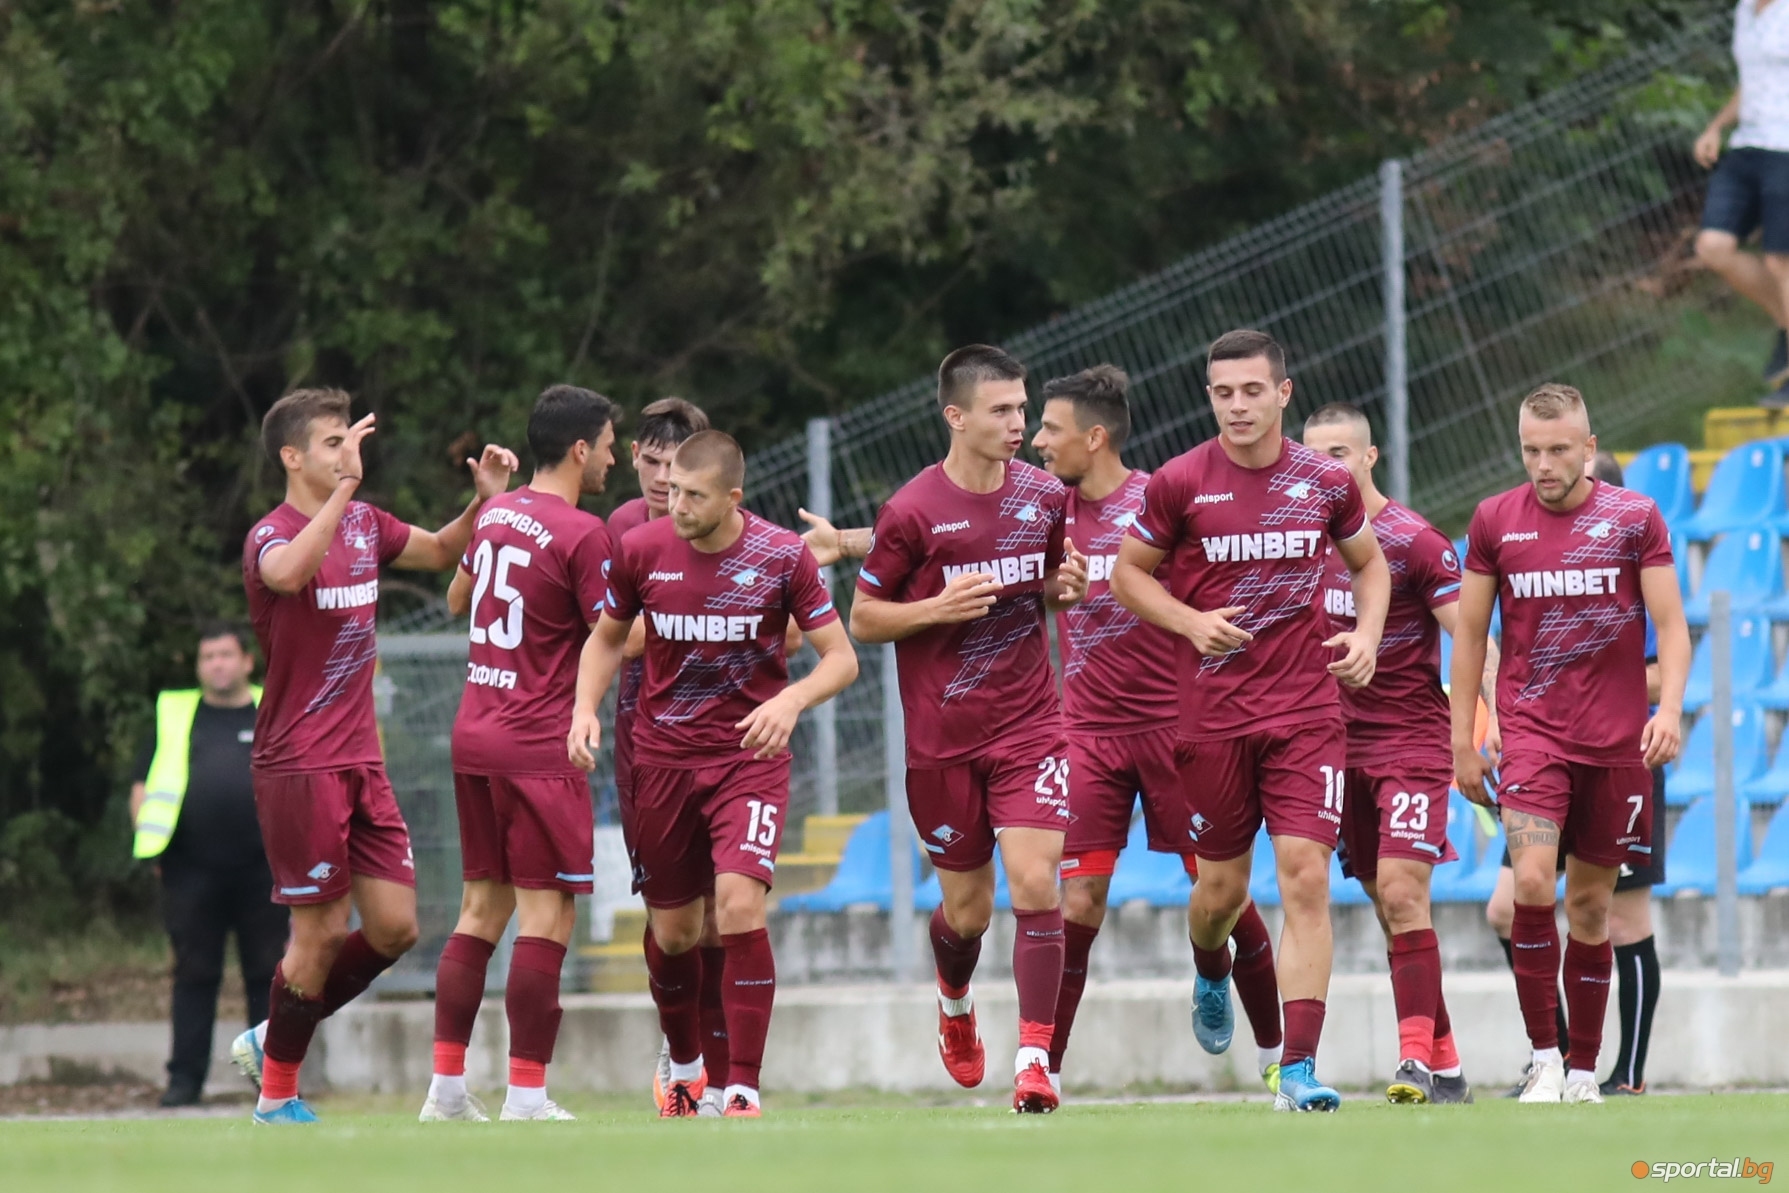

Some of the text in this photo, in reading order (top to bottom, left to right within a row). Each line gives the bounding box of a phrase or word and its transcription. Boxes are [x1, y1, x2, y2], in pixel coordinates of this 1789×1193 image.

[1194, 491, 1234, 505] uhlsport
[930, 519, 971, 535] uhlsport
[1501, 531, 1539, 543] uhlsport
[1201, 530, 1322, 562] WINBET
[648, 571, 684, 583] uhlsport
[1507, 567, 1621, 599] WINBET
[469, 539, 532, 650] 25
[650, 611, 764, 642] WINBET
[746, 799, 778, 847] 15
[1390, 791, 1430, 831] 23
[1626, 795, 1643, 834] 7
[739, 842, 771, 858] uhlsport
[1390, 830, 1425, 840] uhlsport
